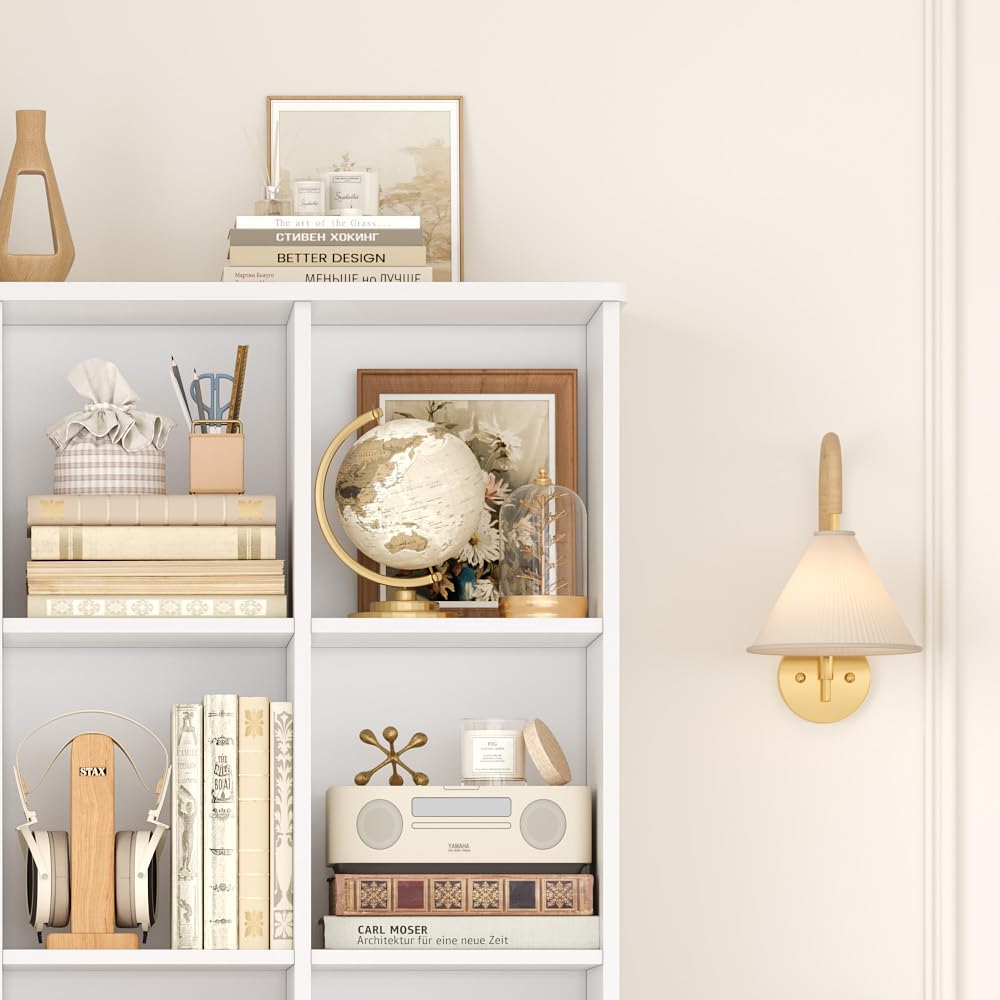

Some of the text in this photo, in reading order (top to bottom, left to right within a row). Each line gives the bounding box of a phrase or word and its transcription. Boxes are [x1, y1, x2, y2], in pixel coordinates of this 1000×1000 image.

[275, 219, 290, 227] The
[295, 219, 309, 227] art
[315, 219, 325, 227] of
[332, 219, 346, 227] the
[276, 232, 380, 242] СТИВЕН ХОКИНГ
[277, 253, 386, 263] BETTER DESIGN
[80, 767, 106, 777] STAX
[214, 778, 231, 790] BOAT
[358, 925, 428, 935] CARL MOSER
[357, 935, 415, 945] Architektur
[418, 935, 432, 945] für
[436, 936, 458, 945] eine
[489, 935, 509, 945] Zeit
